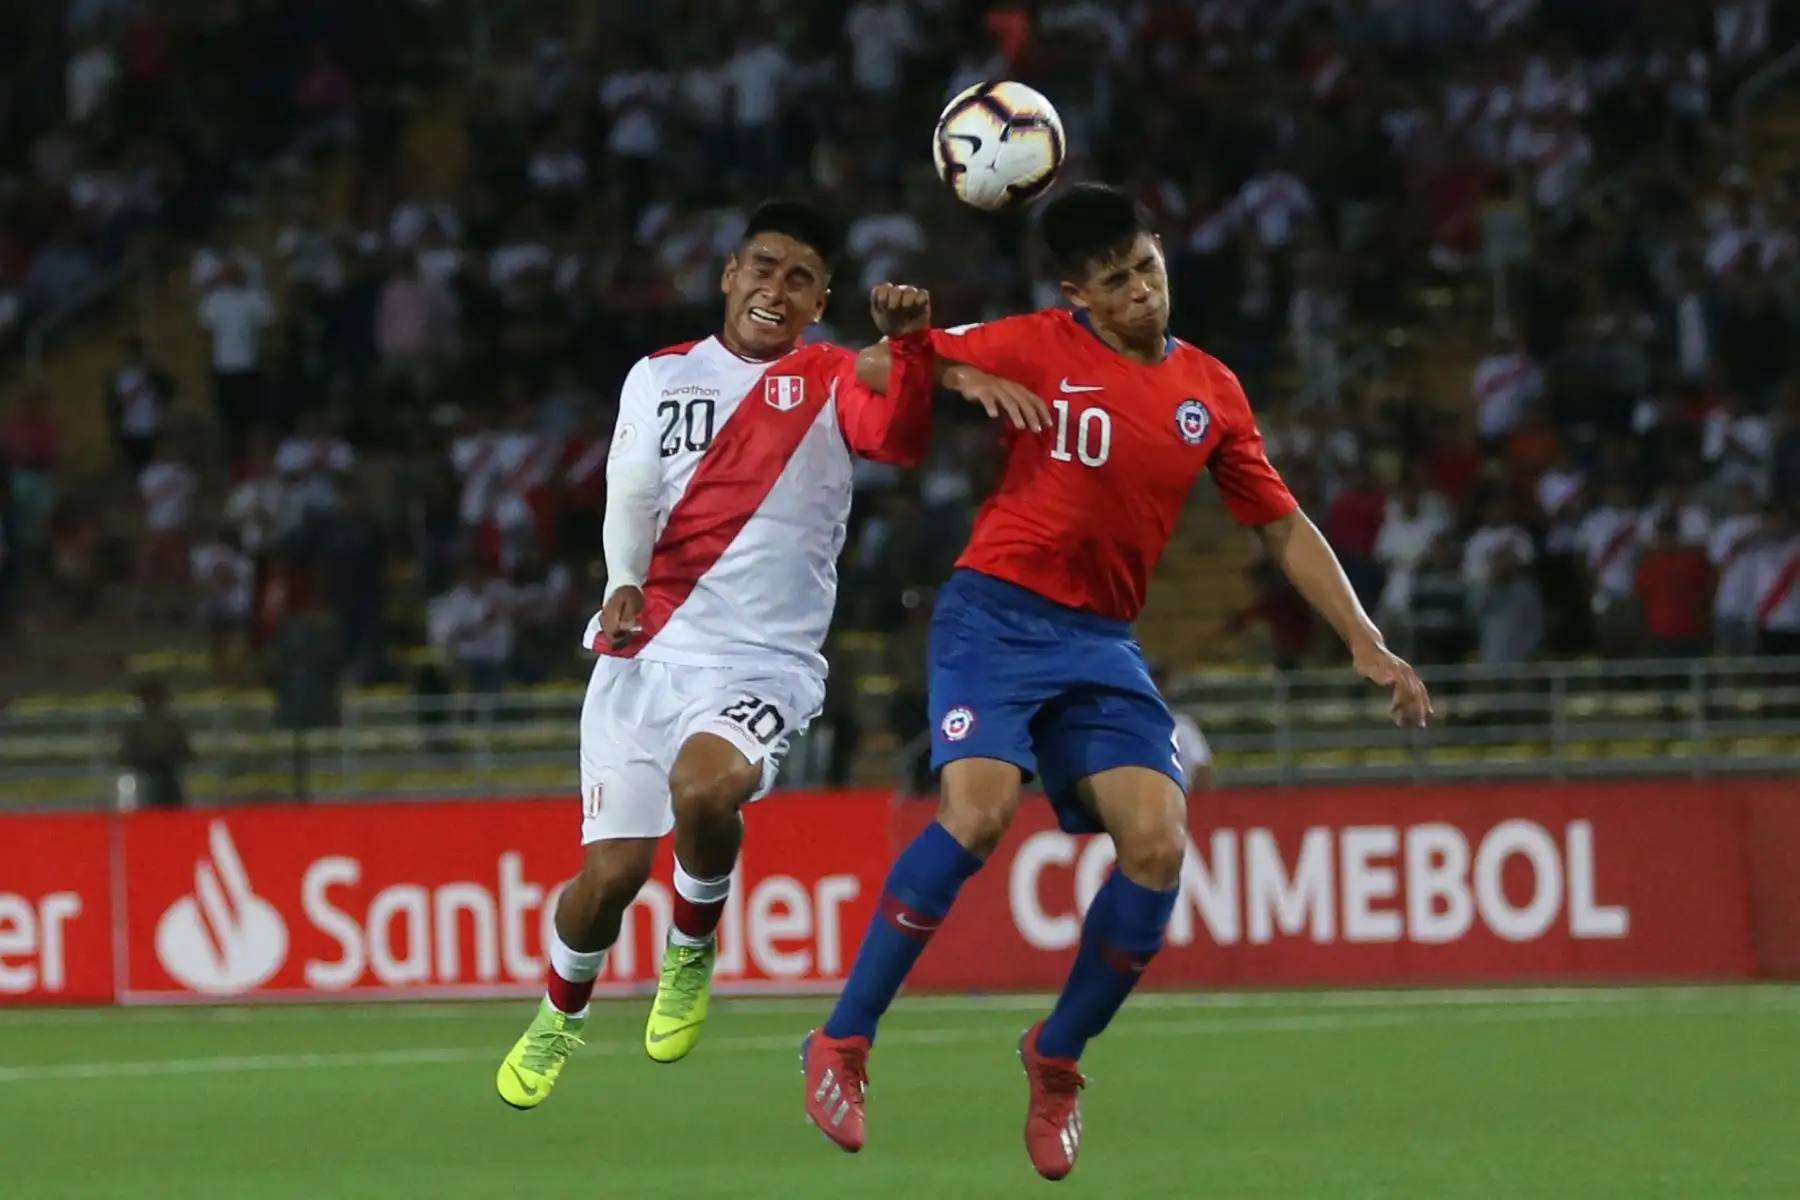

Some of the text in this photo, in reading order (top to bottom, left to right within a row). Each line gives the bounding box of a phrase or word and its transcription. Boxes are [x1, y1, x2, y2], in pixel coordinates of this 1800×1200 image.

[657, 398, 715, 458] 20
[1051, 399, 1112, 467] 10
[720, 697, 785, 745] 20
[302, 847, 860, 989] Santner
